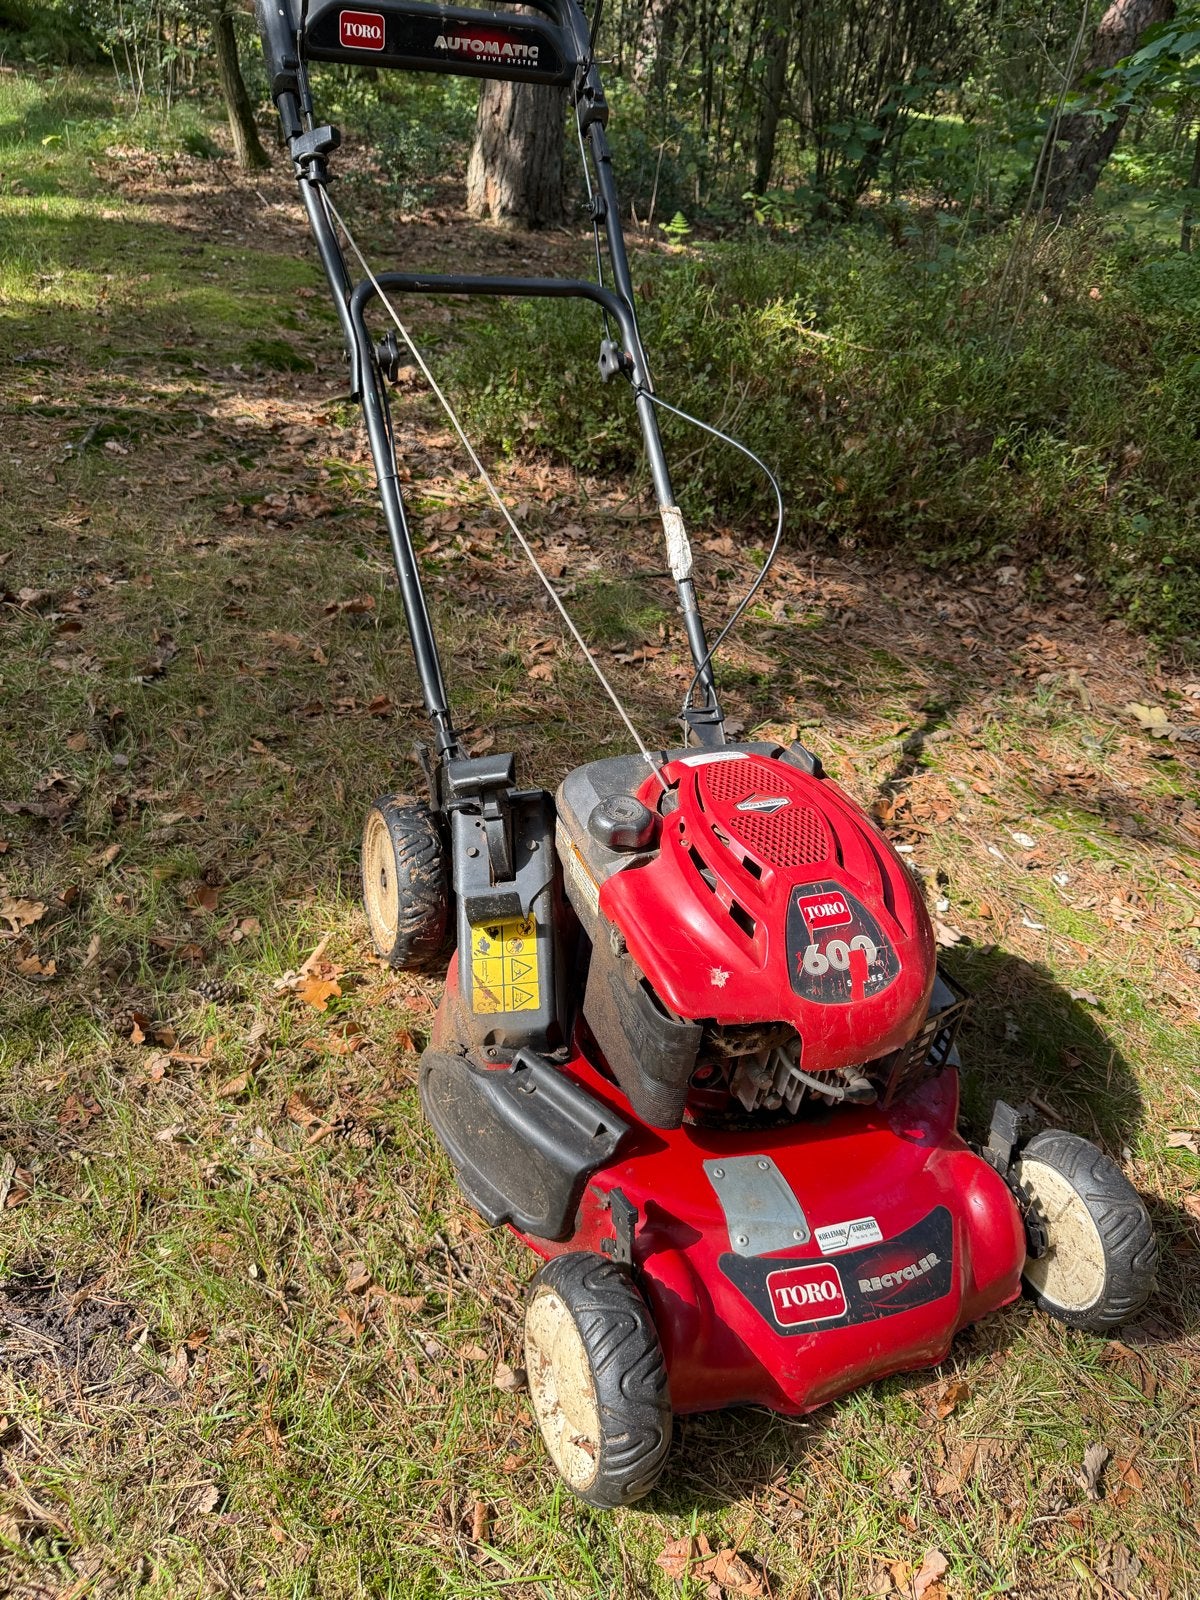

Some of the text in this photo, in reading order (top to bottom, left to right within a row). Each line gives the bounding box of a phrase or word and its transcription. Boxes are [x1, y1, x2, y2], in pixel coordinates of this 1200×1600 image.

[343, 22, 381, 39] TORO
[434, 35, 539, 59] AUTOMATIC
[476, 54, 538, 67] DRIVE SYSTEM
[804, 901, 845, 920] TORO
[803, 935, 877, 976] 600
[846, 973, 884, 987] SES
[858, 1252, 942, 1294] RECYCLER
[775, 1280, 838, 1309] TORO
